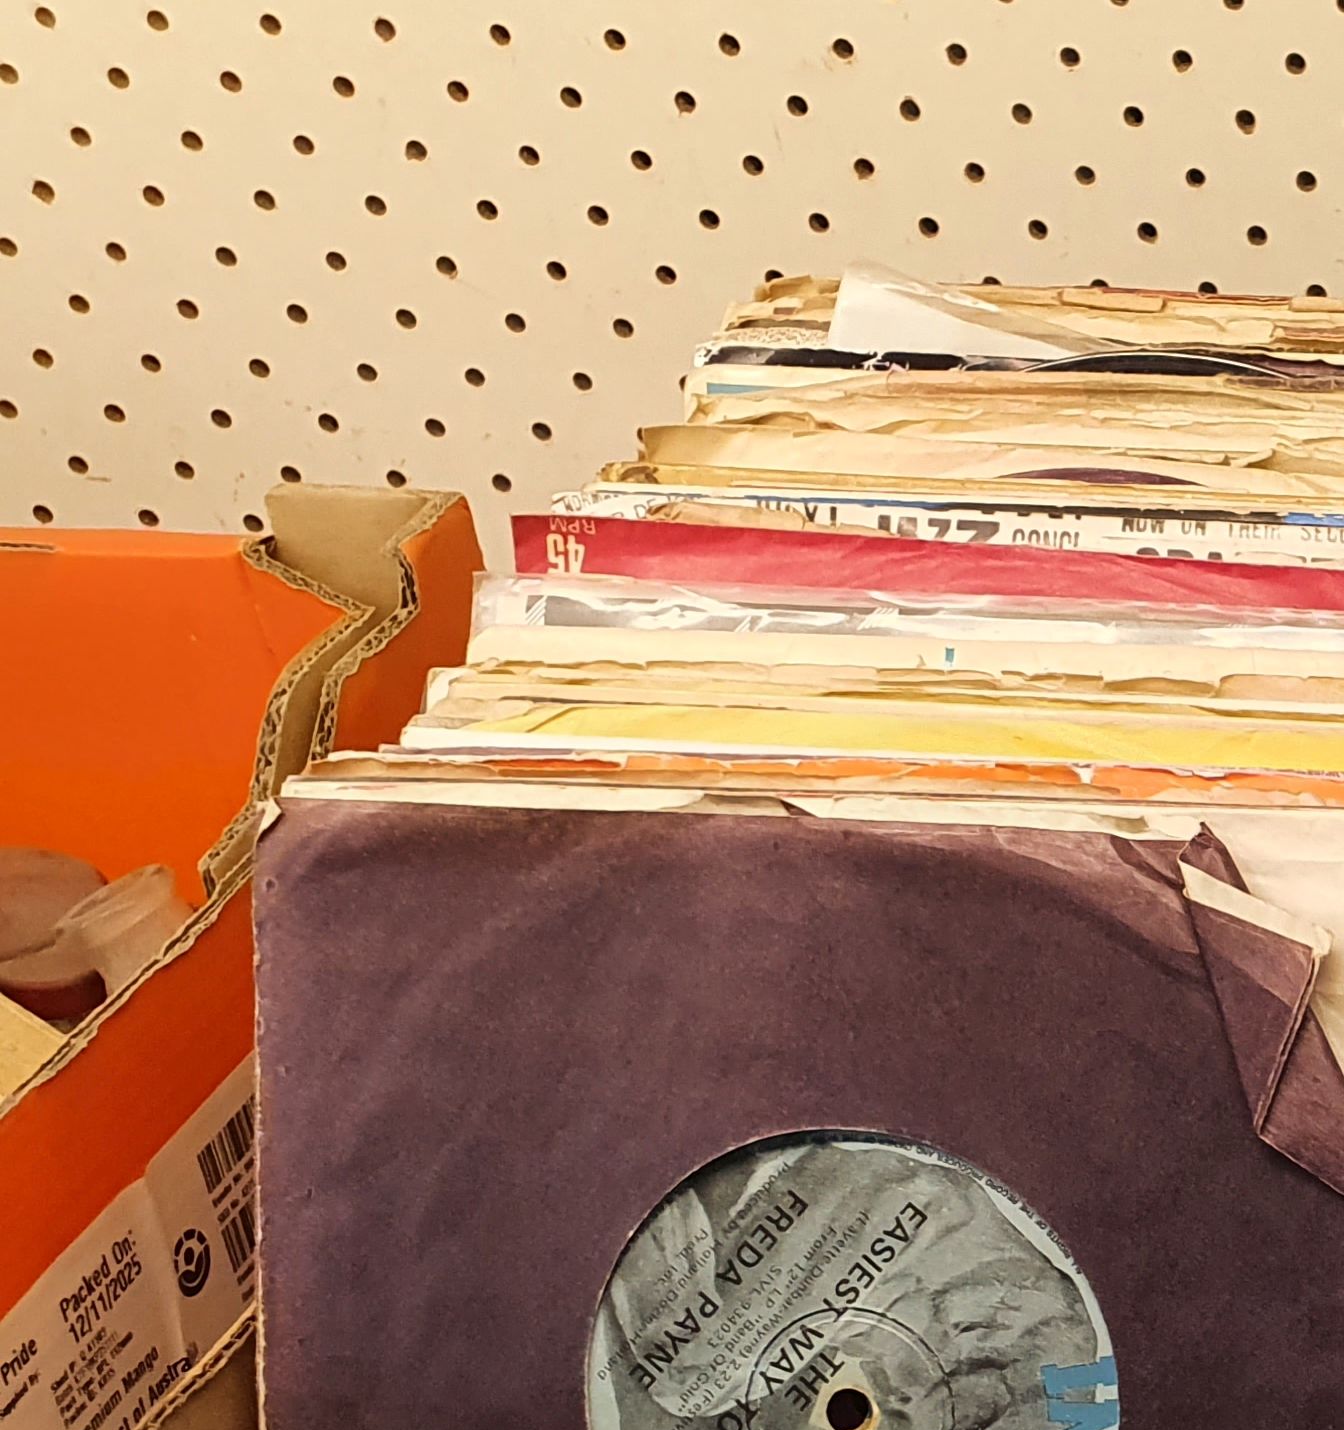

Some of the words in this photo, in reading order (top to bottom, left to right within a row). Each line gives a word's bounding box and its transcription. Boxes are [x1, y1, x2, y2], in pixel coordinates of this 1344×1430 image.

[59, 1254, 111, 1323] Packed
[111, 1229, 137, 1265] On:
[714, 1187, 810, 1294] FREDA
[816, 1199, 929, 1326] EASIEST
[68, 1252, 143, 1344] 12/11/2025
[627, 1289, 721, 1393] PAYNE
[0, 1339, 38, 1386] Pride
[121, 1346, 159, 1394] Mango
[753, 1319, 825, 1397] WAY
[783, 1346, 845, 1413] THE
